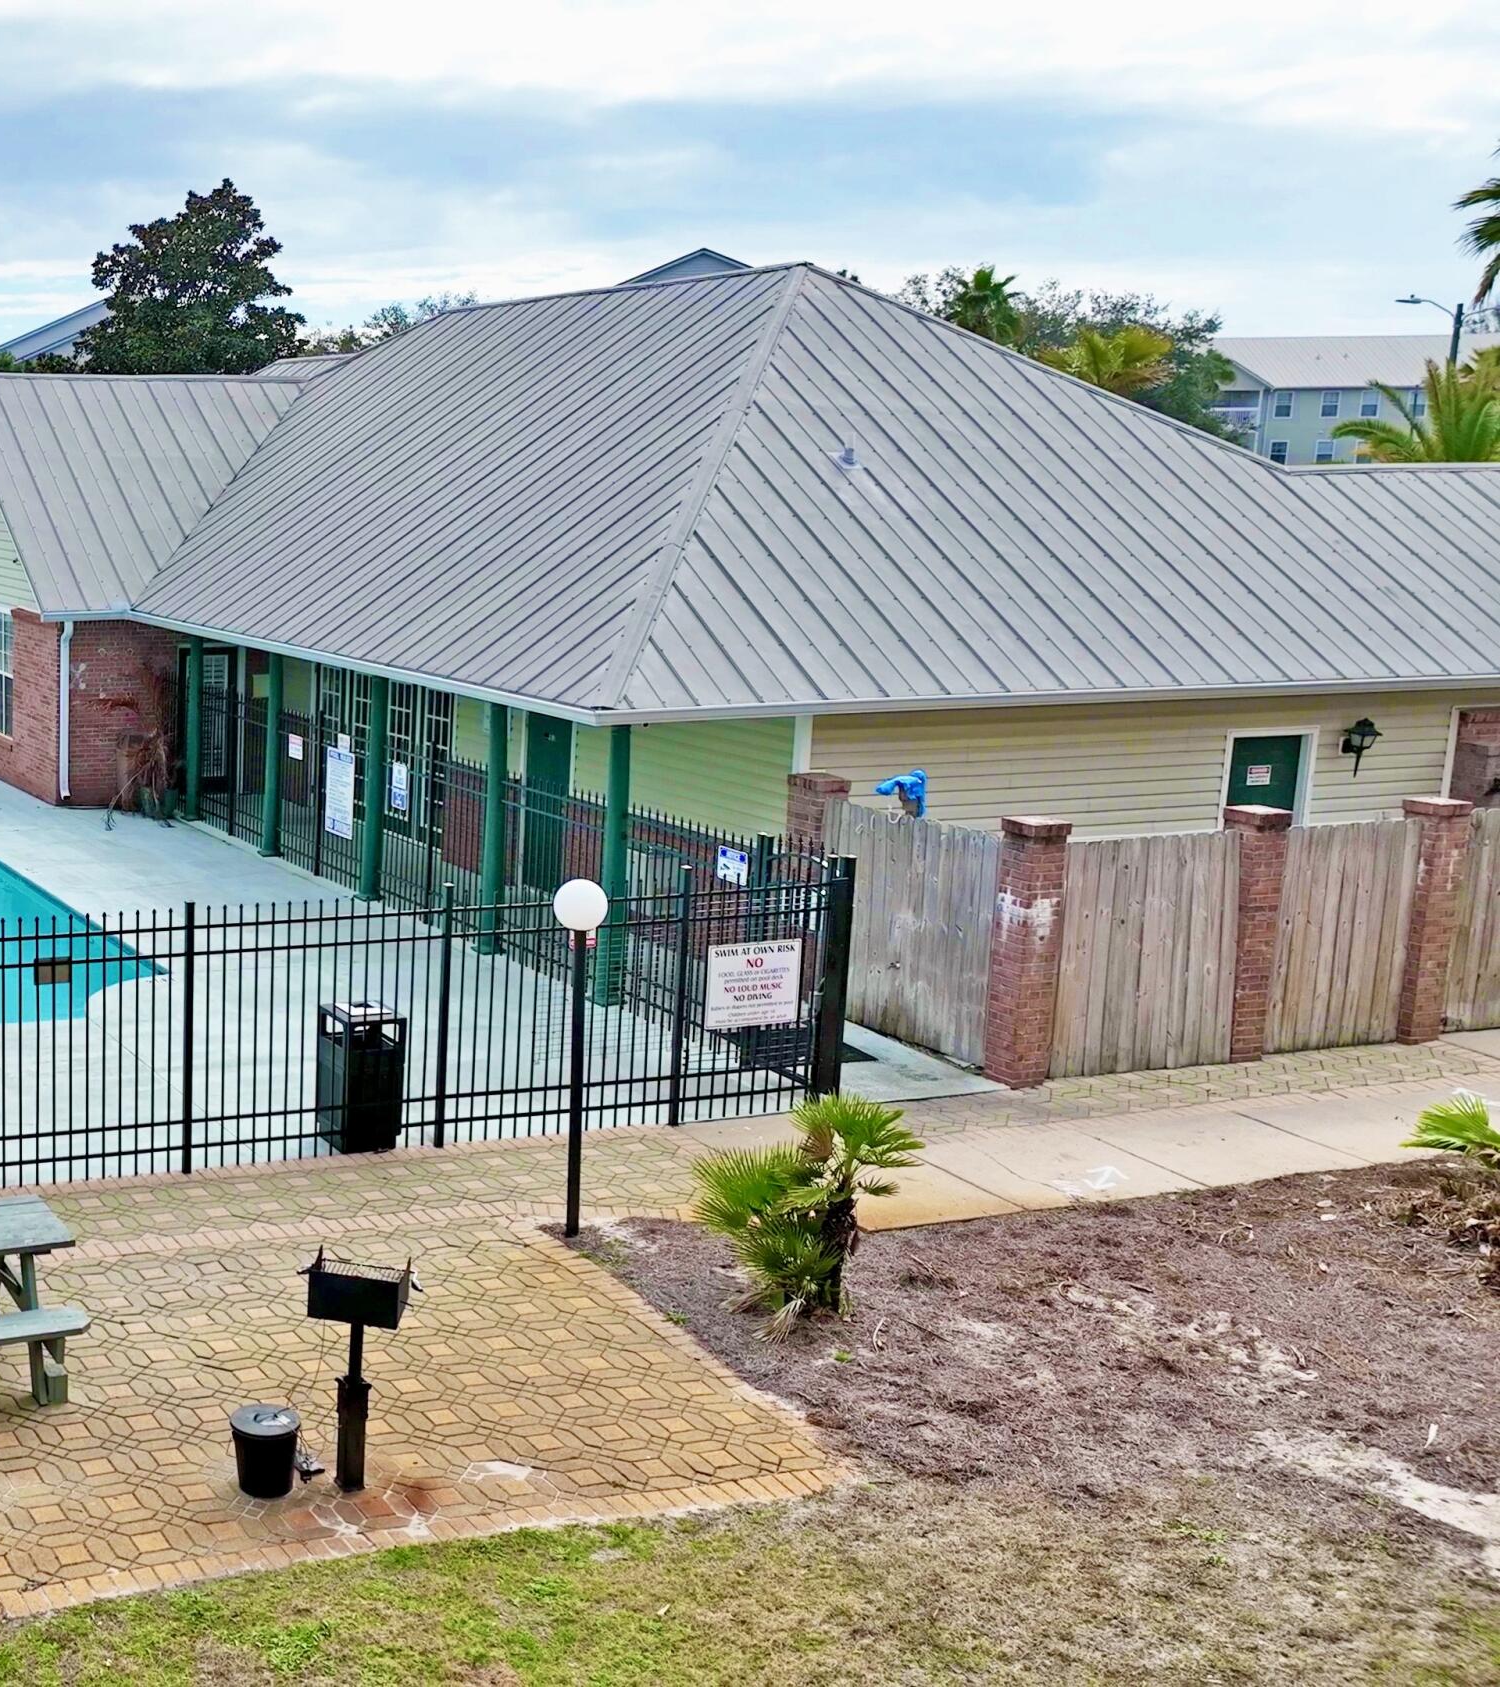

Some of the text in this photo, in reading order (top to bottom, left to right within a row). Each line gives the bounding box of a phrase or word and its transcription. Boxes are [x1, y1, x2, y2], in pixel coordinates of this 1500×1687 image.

[714, 944, 796, 958] SWIM AT OWN RISK
[746, 957, 764, 968] NO
[724, 982, 783, 994] NO LOUD MUSIC
[733, 992, 773, 1002] NO DIVING
